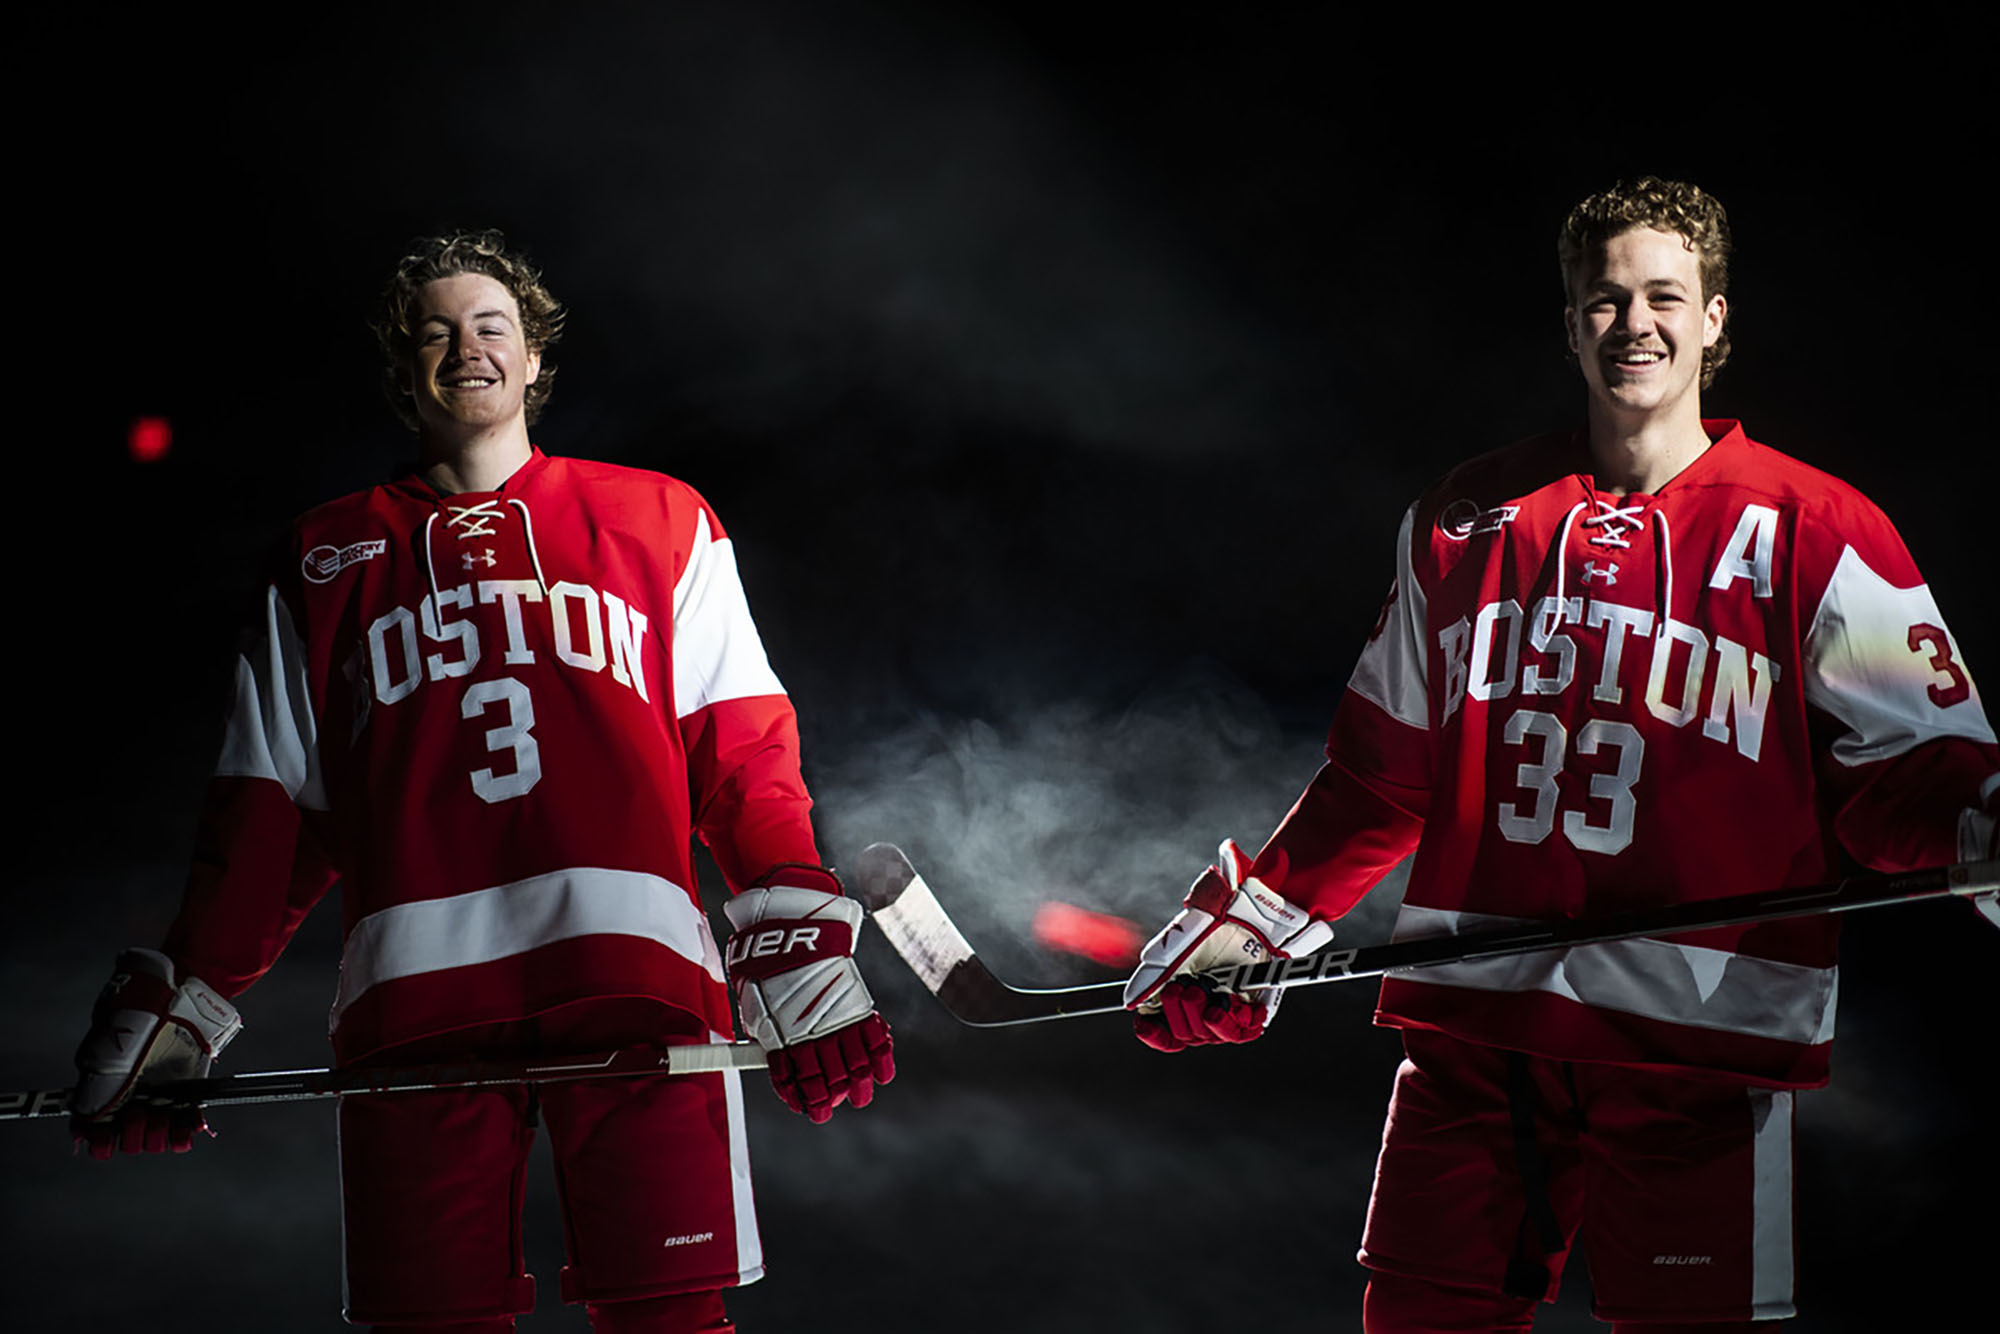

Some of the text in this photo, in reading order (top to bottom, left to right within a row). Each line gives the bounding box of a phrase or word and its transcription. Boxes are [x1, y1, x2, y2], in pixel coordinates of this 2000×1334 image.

[1709, 503, 1780, 599] A
[1439, 596, 1782, 762] BOSTON
[1907, 622, 1969, 709] 3
[460, 676, 543, 804] 3
[1498, 709, 1645, 855] 33
[664, 1231, 715, 1248] BAUER
[1652, 1255, 1713, 1265] BAUER
